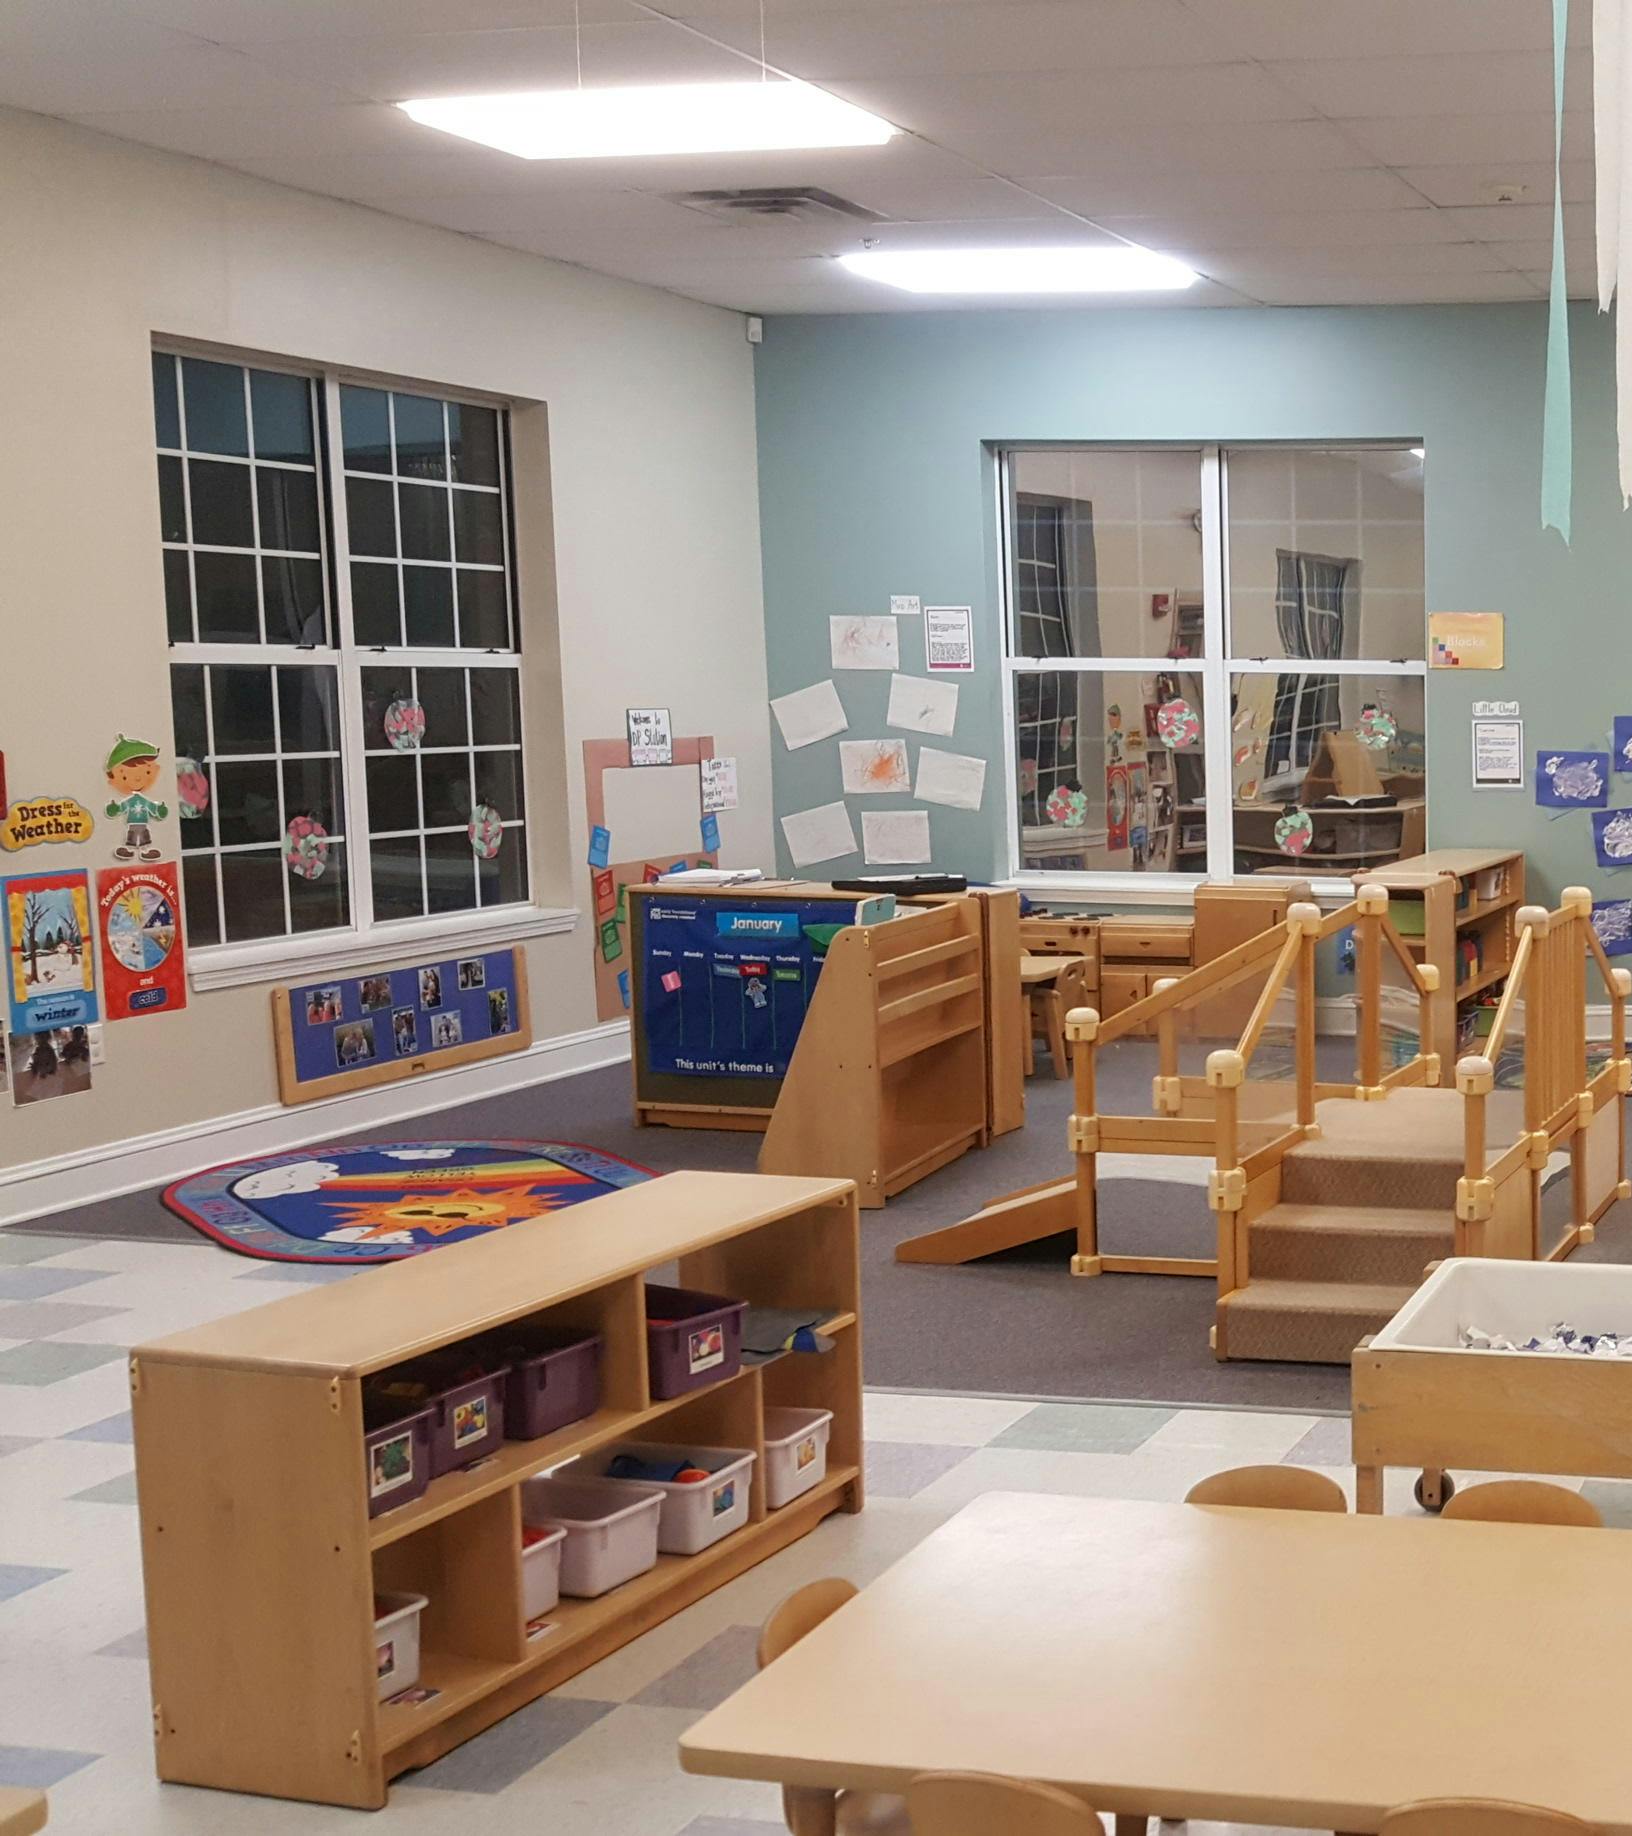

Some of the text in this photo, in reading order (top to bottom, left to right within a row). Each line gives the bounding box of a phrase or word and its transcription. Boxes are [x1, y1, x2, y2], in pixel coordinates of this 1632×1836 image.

[1447, 635, 1487, 648] Blocks
[1474, 703, 1517, 714] Little Cloud
[17, 804, 62, 822] Dress
[10, 818, 82, 842] Weather
[131, 874, 167, 887] weather
[731, 917, 783, 933] January
[652, 949, 672, 958] Sunday
[683, 951, 704, 959] Monday
[713, 952, 734, 960] Tuesday
[740, 953, 771, 961] Wednesday
[776, 955, 800, 963] Thursday
[139, 976, 154, 986] and
[35, 1007, 81, 1022] winter
[675, 1058, 774, 1073] This unit's theme is
